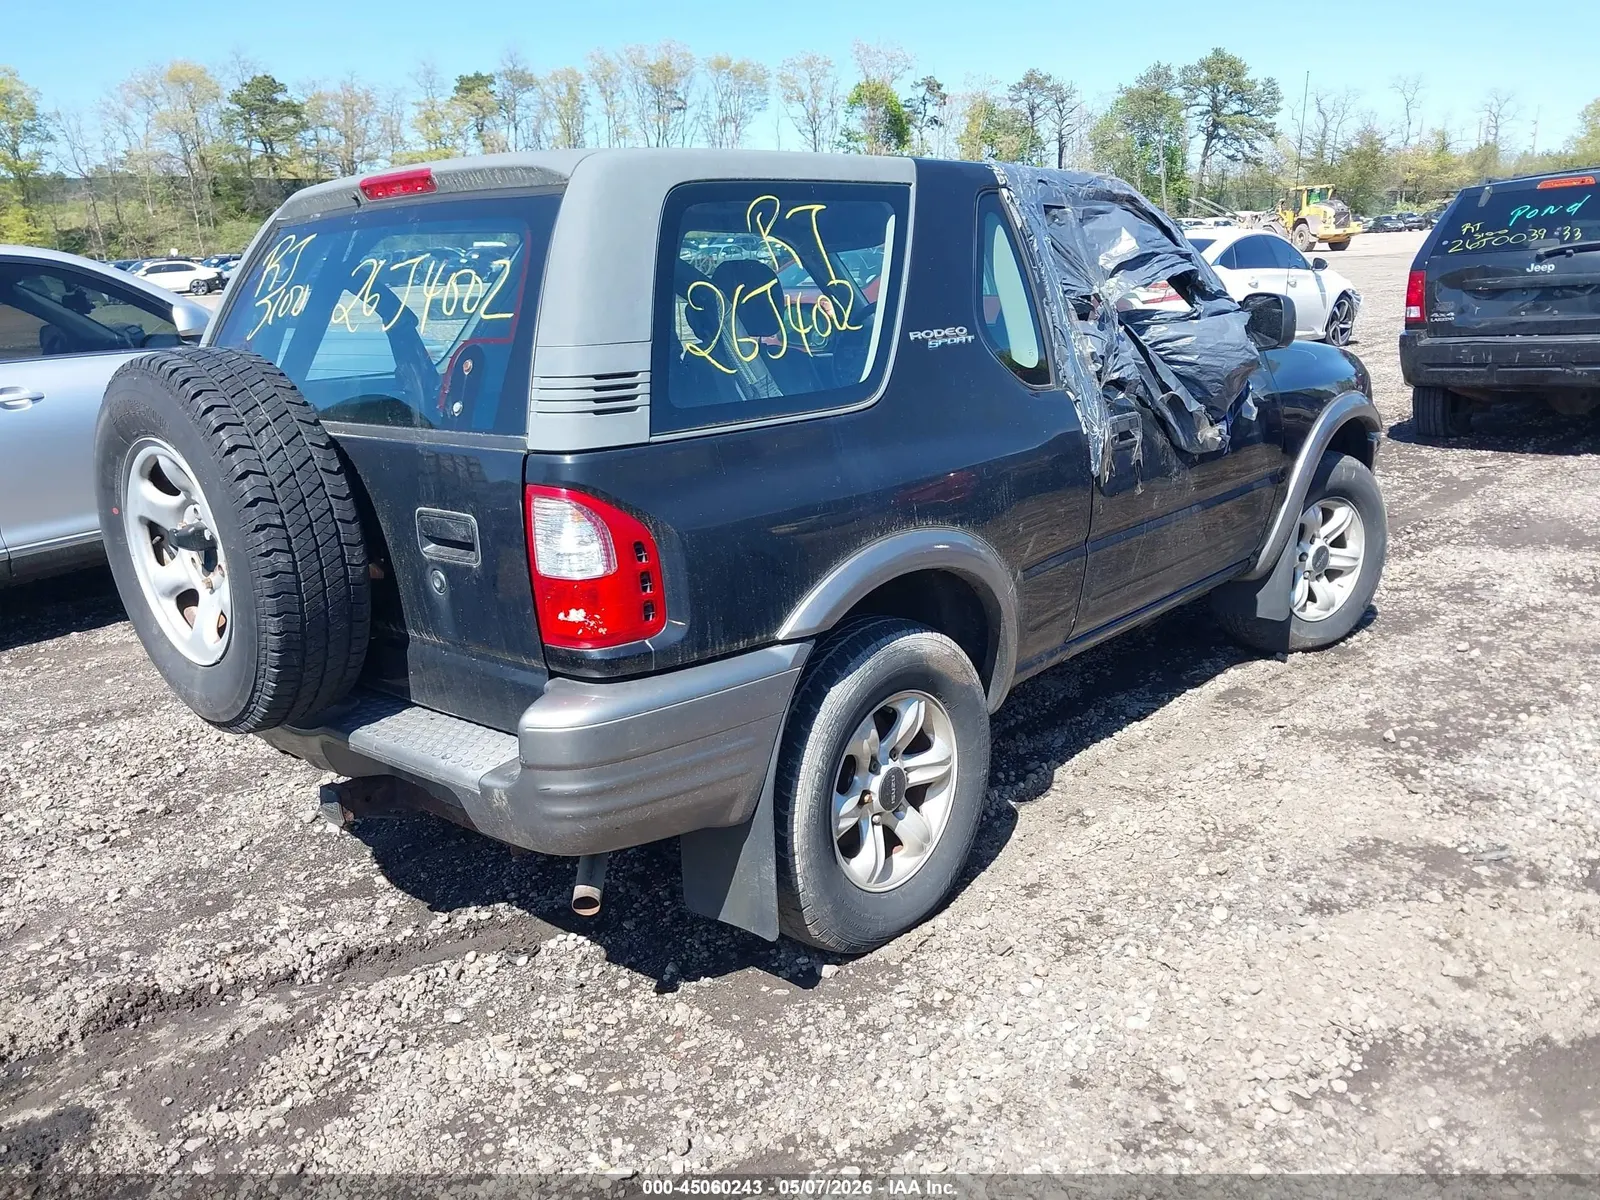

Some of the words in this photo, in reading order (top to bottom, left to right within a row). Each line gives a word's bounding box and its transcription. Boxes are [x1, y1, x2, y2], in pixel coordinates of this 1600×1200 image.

[1526, 263, 1555, 273] Jeep
[331, 253, 515, 336] 26J4002
[909, 326, 968, 341] RODEO
[928, 334, 975, 350] SPORT
